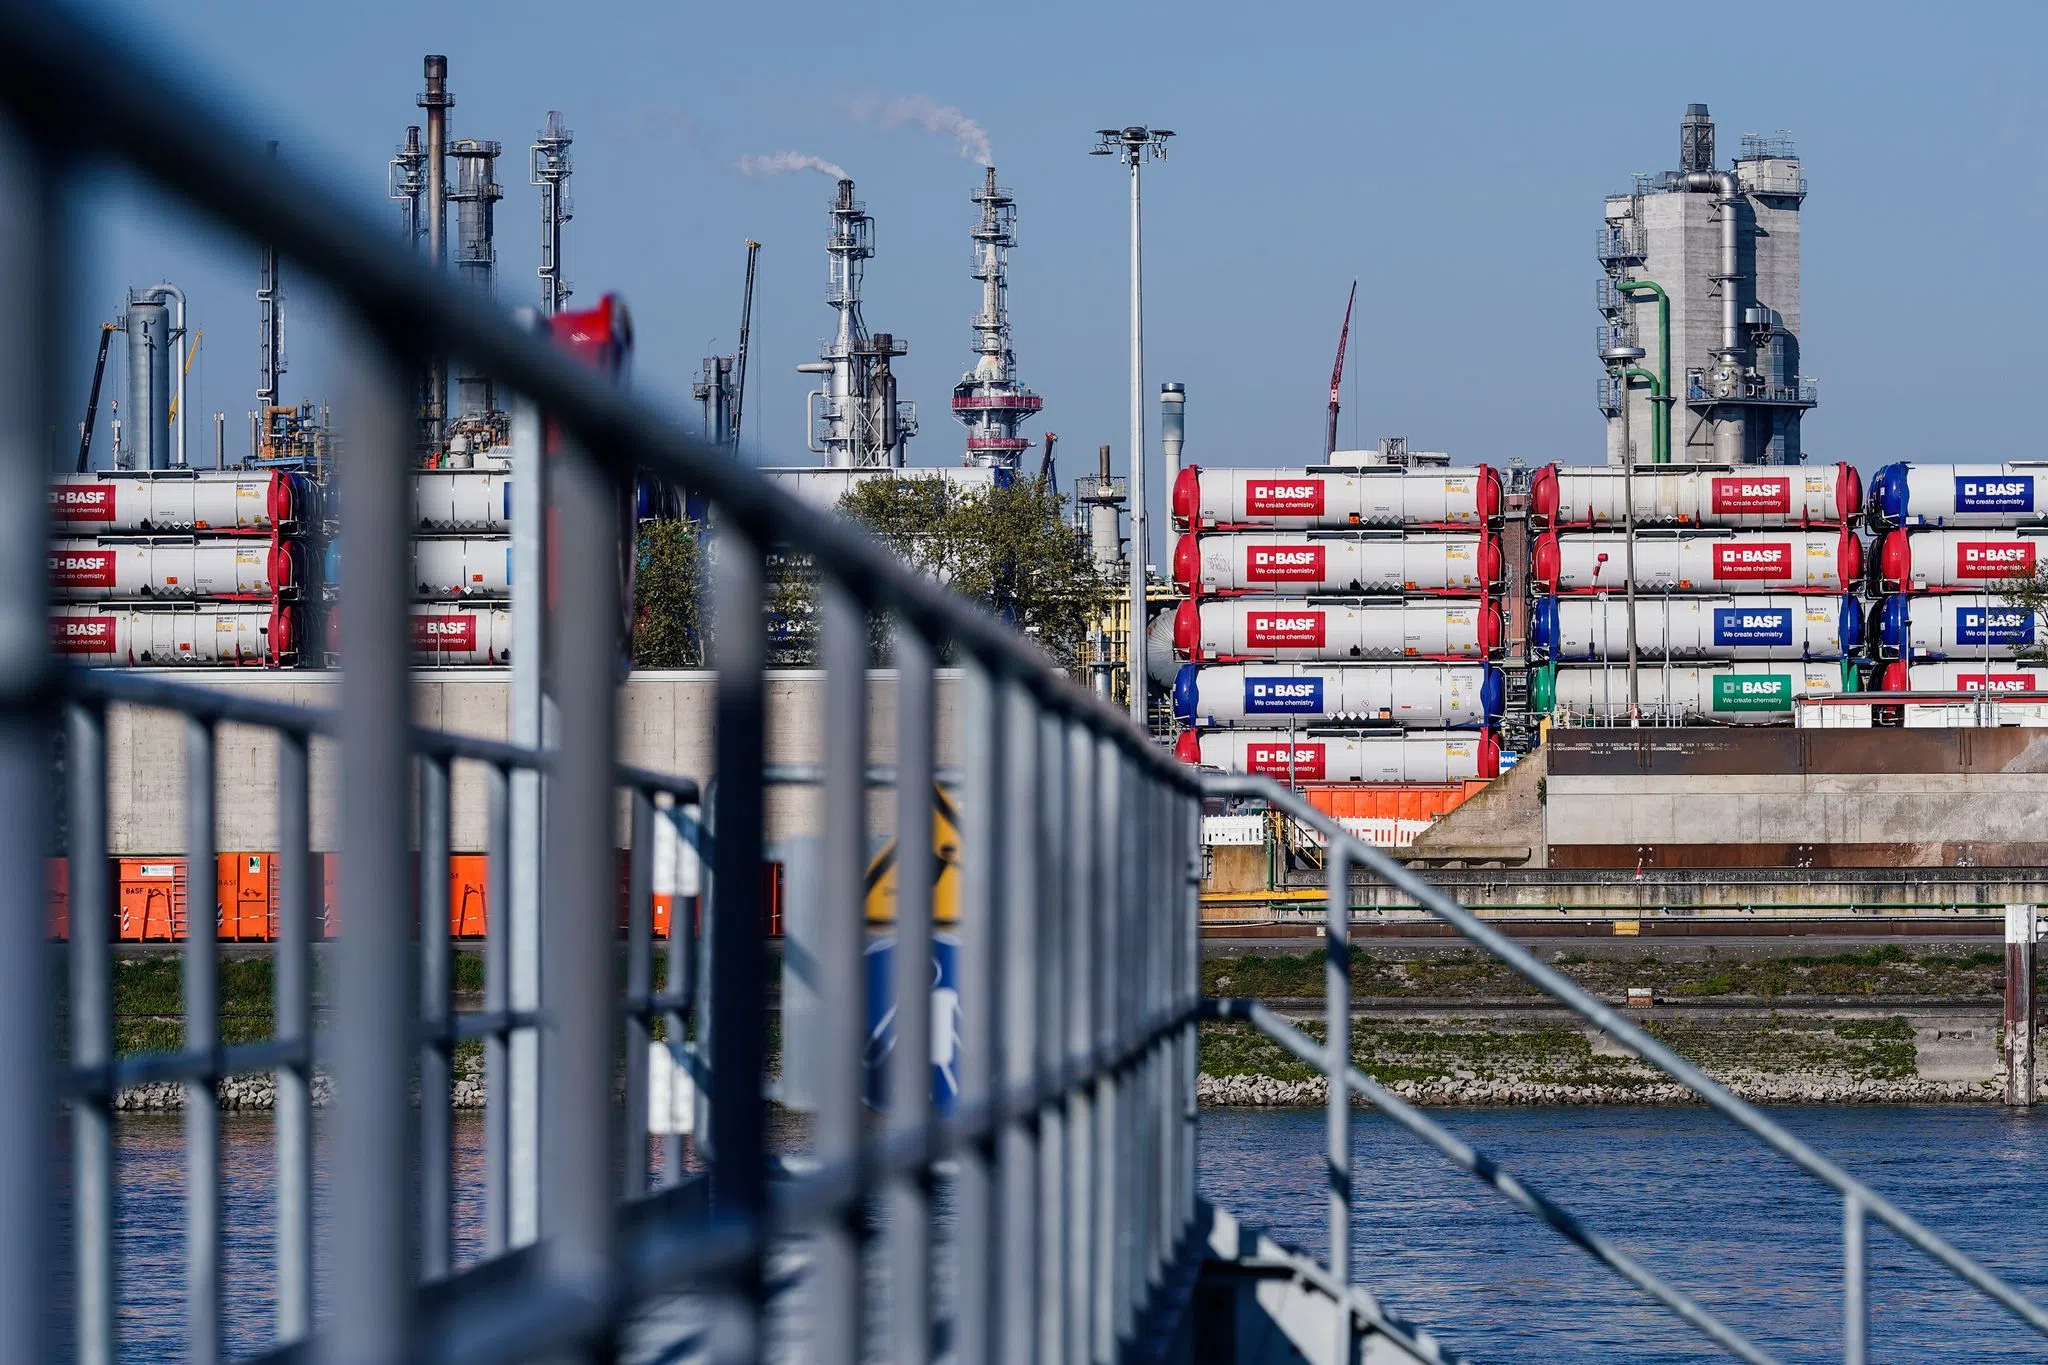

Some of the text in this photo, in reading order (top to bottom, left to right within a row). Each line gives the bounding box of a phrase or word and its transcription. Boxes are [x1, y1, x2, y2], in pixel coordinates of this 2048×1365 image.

[1276, 486, 1315, 498] BASF
[1743, 484, 1782, 496] BASF
[1985, 483, 2024, 495] BASF
[66, 491, 105, 503] BASF
[1995, 498, 2025, 506] chemistry
[1277, 552, 1316, 564] BASF
[1743, 549, 1782, 562] BASF
[1987, 549, 2026, 561] BASF
[66, 557, 105, 569] BASF
[76, 572, 106, 580] chemistry
[1277, 618, 1316, 630] BASF
[1744, 615, 1782, 627] BASF
[66, 623, 105, 635] BASF
[427, 622, 466, 634] BASF
[1753, 631, 1783, 639] chemistry
[76, 638, 106, 646] chemistry
[1275, 684, 1314, 696] BASF
[1743, 681, 1783, 693] BASF
[1987, 680, 2025, 691] BASF
